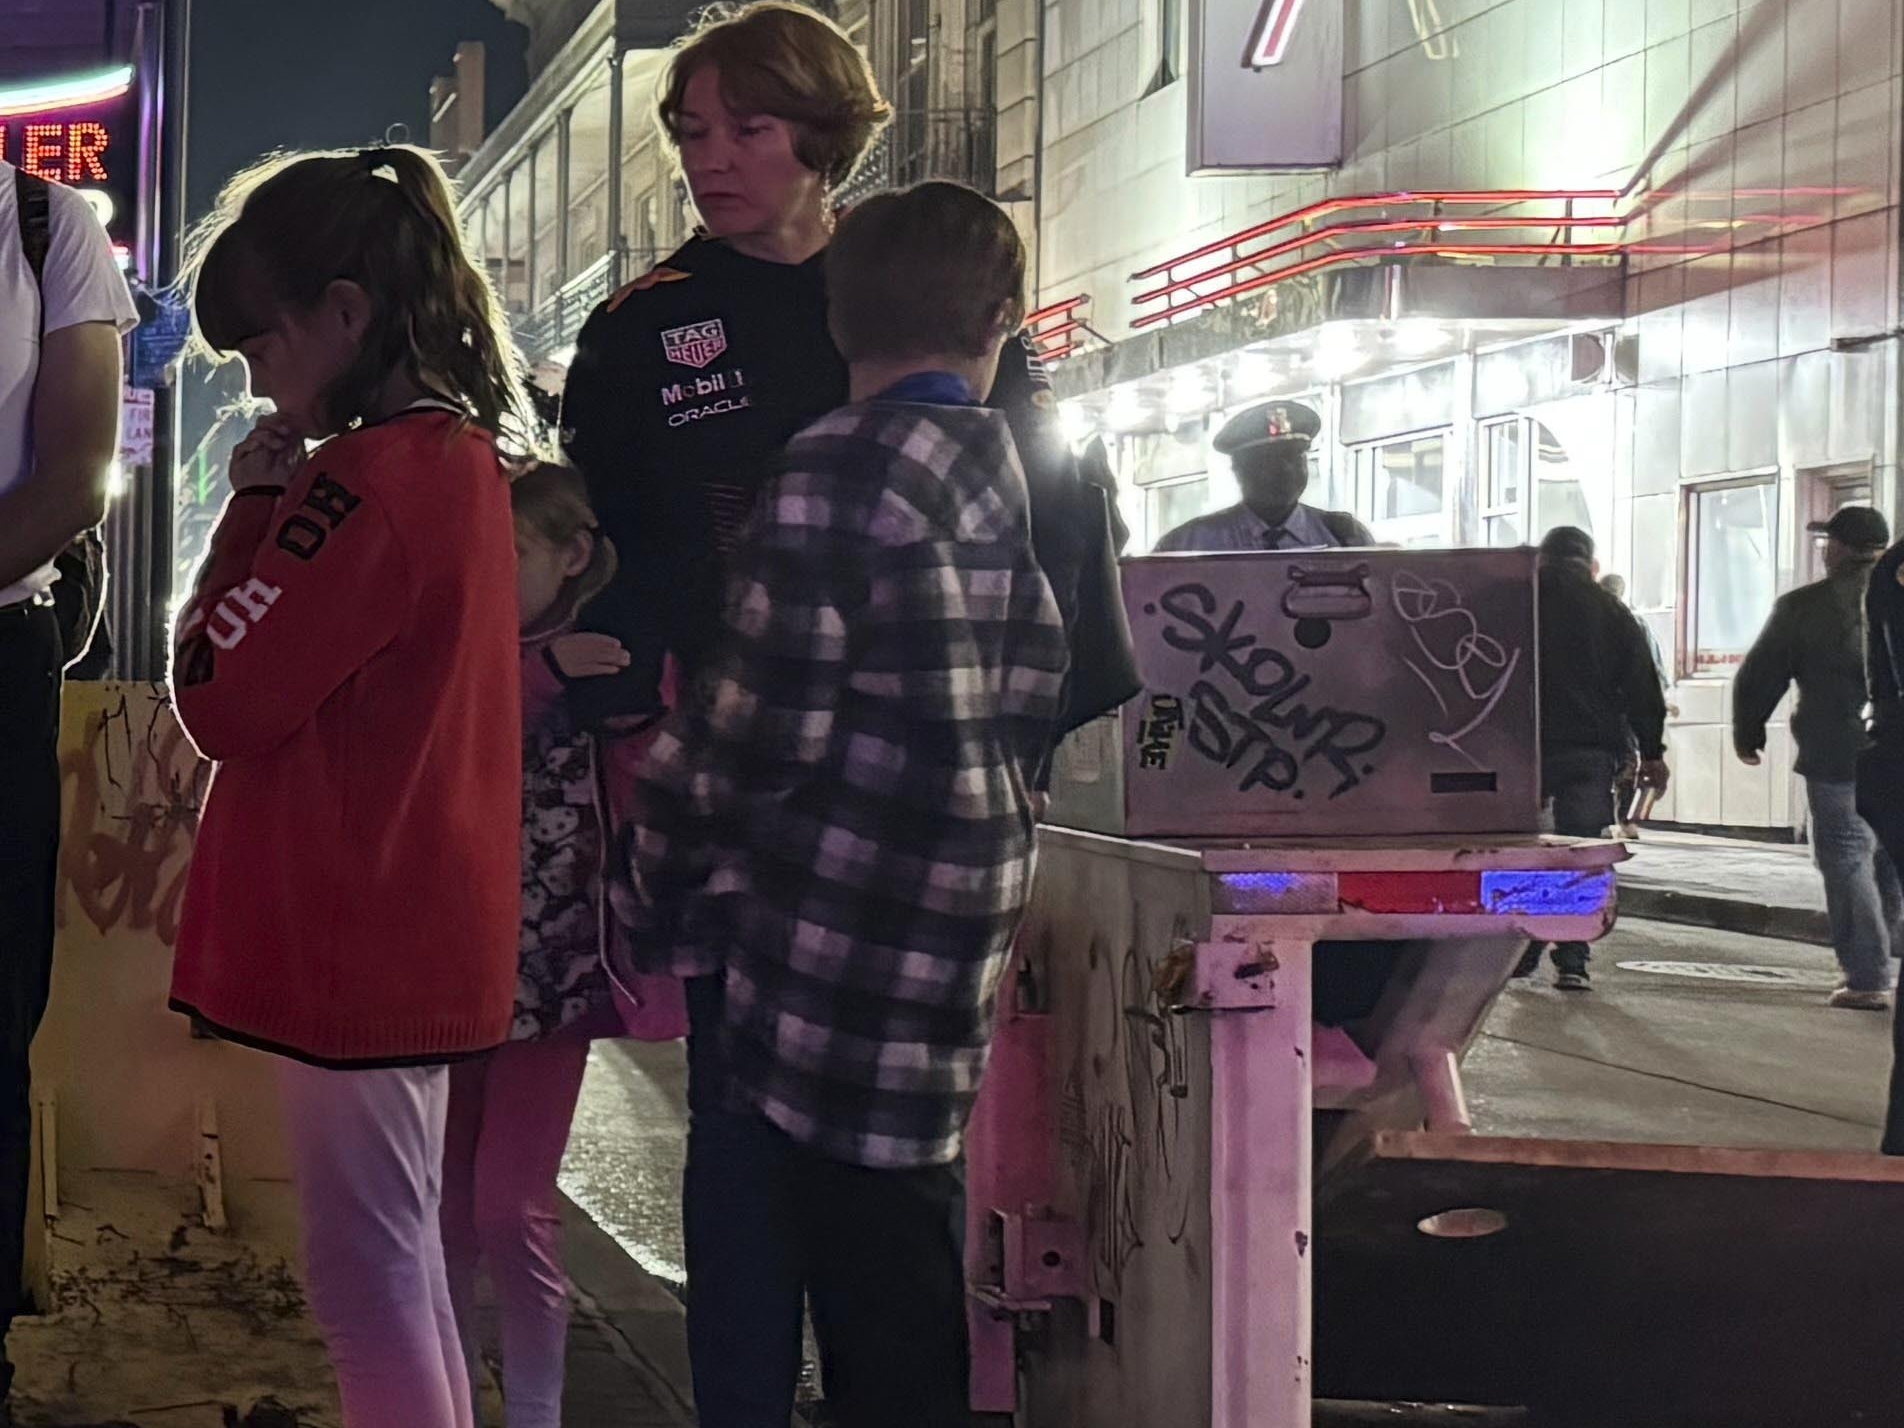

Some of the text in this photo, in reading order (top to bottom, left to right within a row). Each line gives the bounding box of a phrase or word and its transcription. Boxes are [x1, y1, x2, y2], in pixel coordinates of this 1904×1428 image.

[667, 323, 719, 344] TAG
[669, 339, 722, 365] HEUER
[661, 373, 726, 406] Mobil
[668, 396, 749, 427] ORACLE
[276, 473, 363, 561] OH
